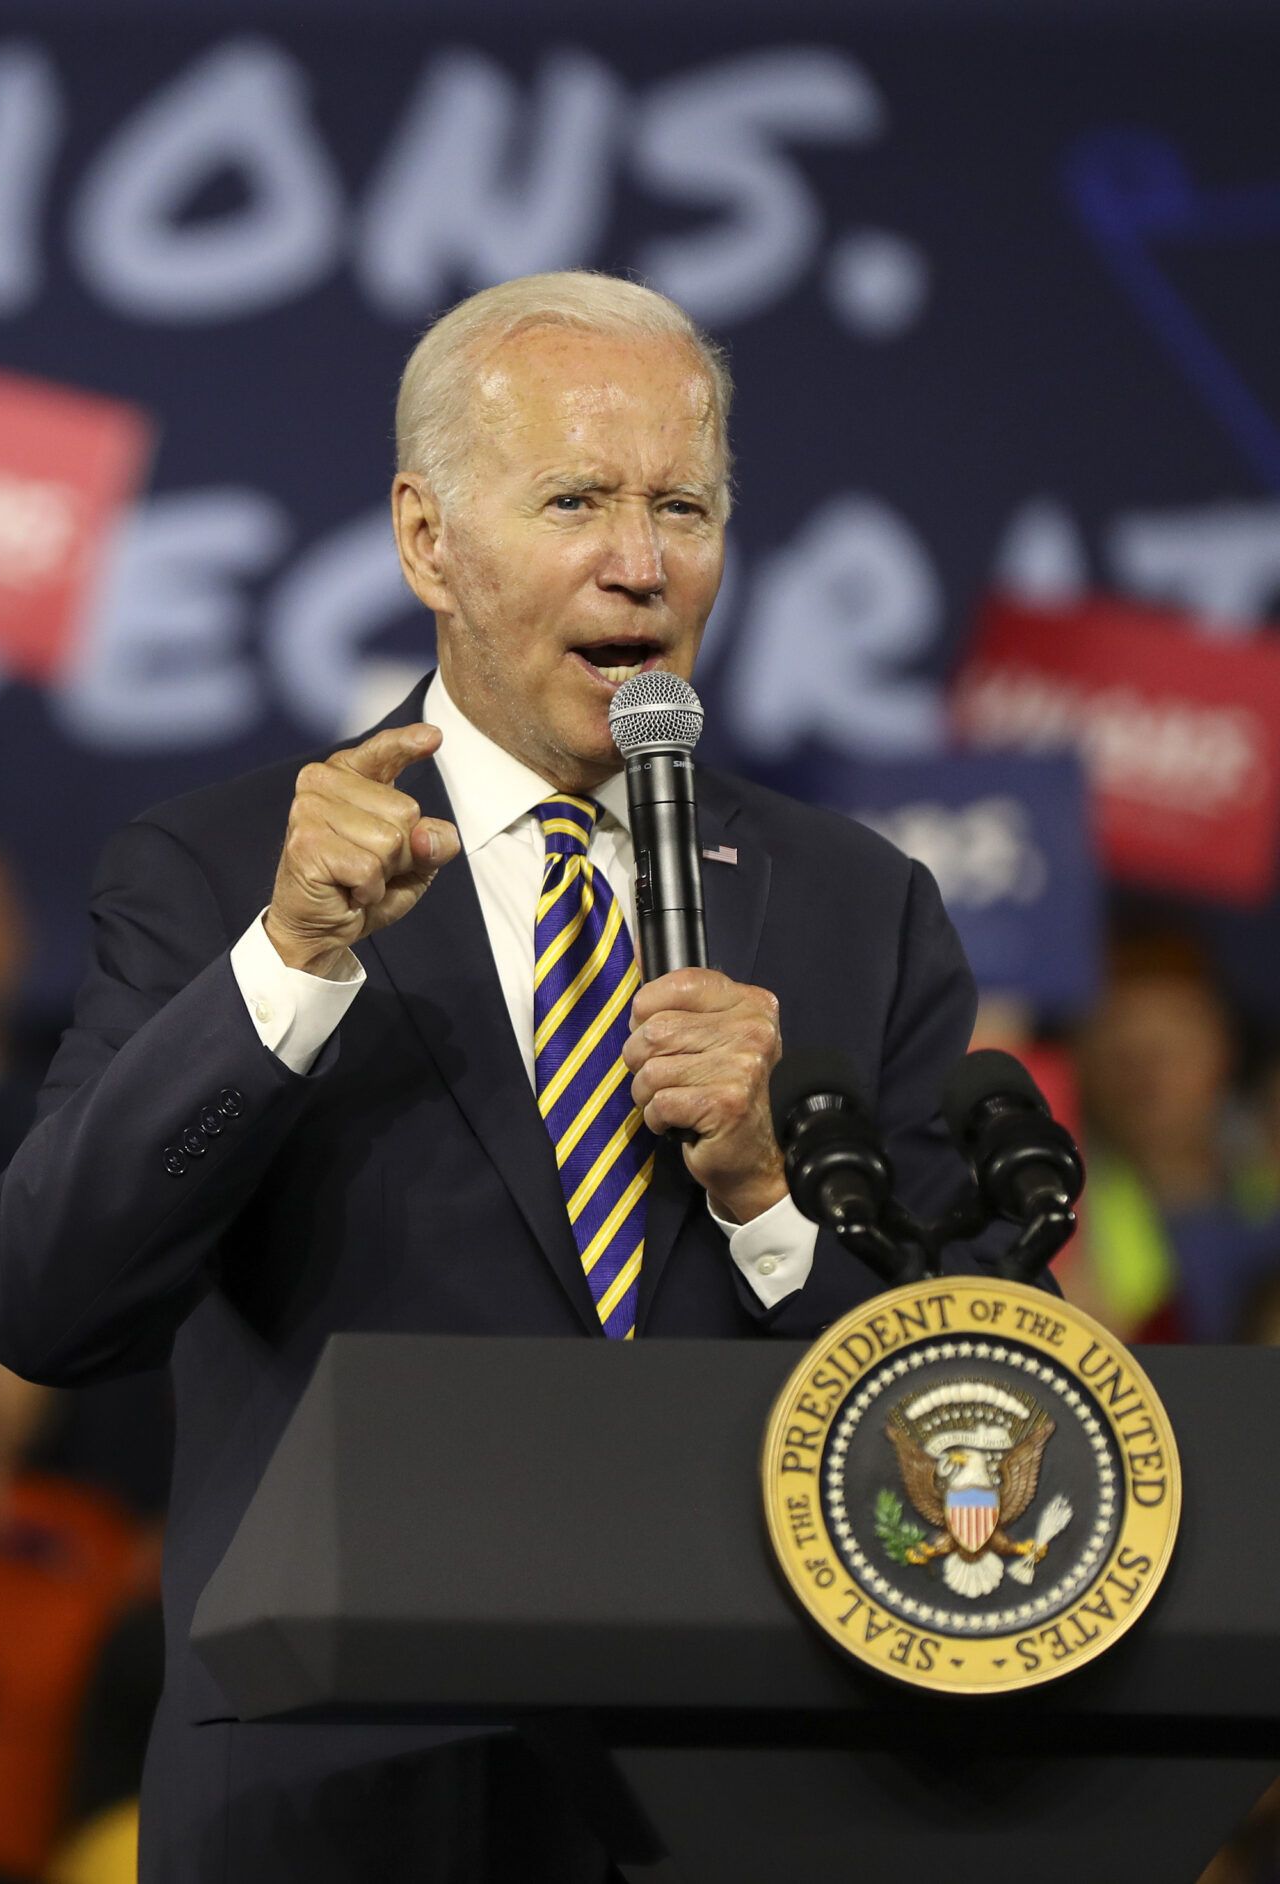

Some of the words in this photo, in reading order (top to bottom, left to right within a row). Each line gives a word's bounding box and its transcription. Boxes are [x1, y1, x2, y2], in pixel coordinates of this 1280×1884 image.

[970, 1300, 1006, 1324] OF
[1016, 1306, 1067, 1347] THE
[782, 1294, 956, 1476] PRESIDENT
[1078, 1341, 1167, 1508] UNITED
[787, 1494, 818, 1549] THE
[805, 1558, 836, 1588] OF
[837, 1589, 941, 1671] SEAL
[1015, 1547, 1152, 1672] STATES
